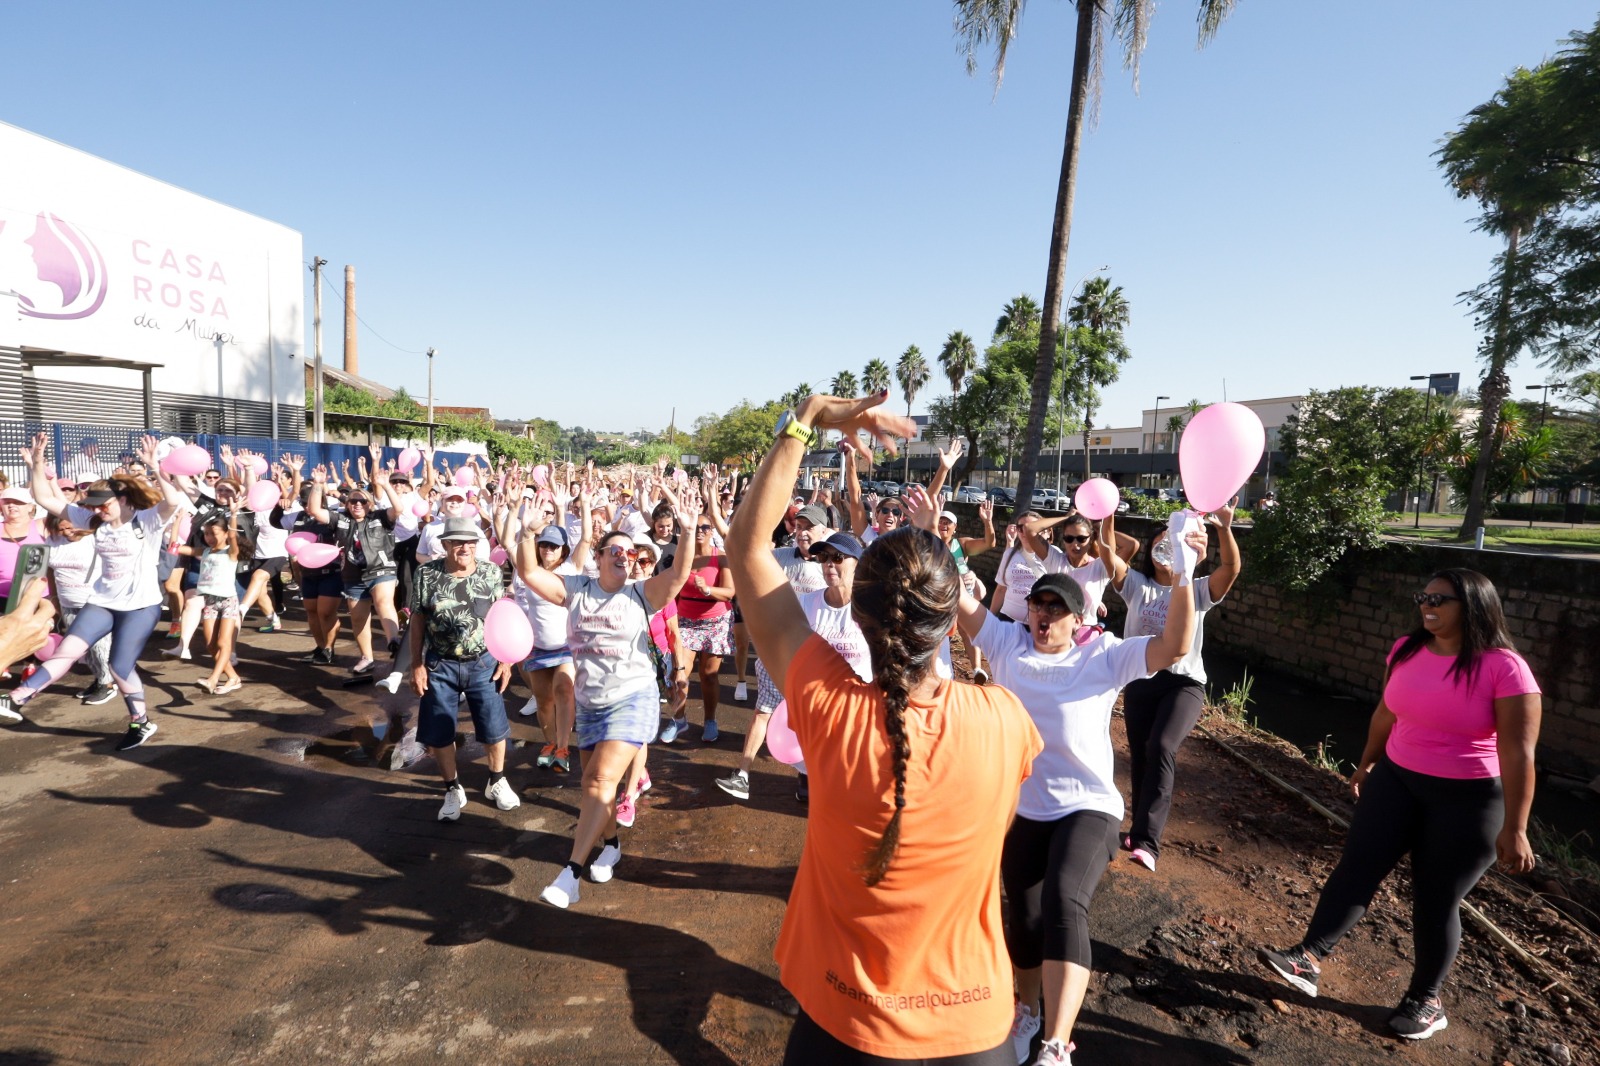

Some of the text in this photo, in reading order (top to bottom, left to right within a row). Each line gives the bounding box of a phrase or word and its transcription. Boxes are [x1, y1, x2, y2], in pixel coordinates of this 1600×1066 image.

[132, 239, 227, 285] CASA
[133, 275, 229, 320] ROSA
[134, 312, 238, 346] da Mulher
[1142, 609, 1167, 619] CORA
[825, 969, 992, 1013] #teamnajaralouzada
